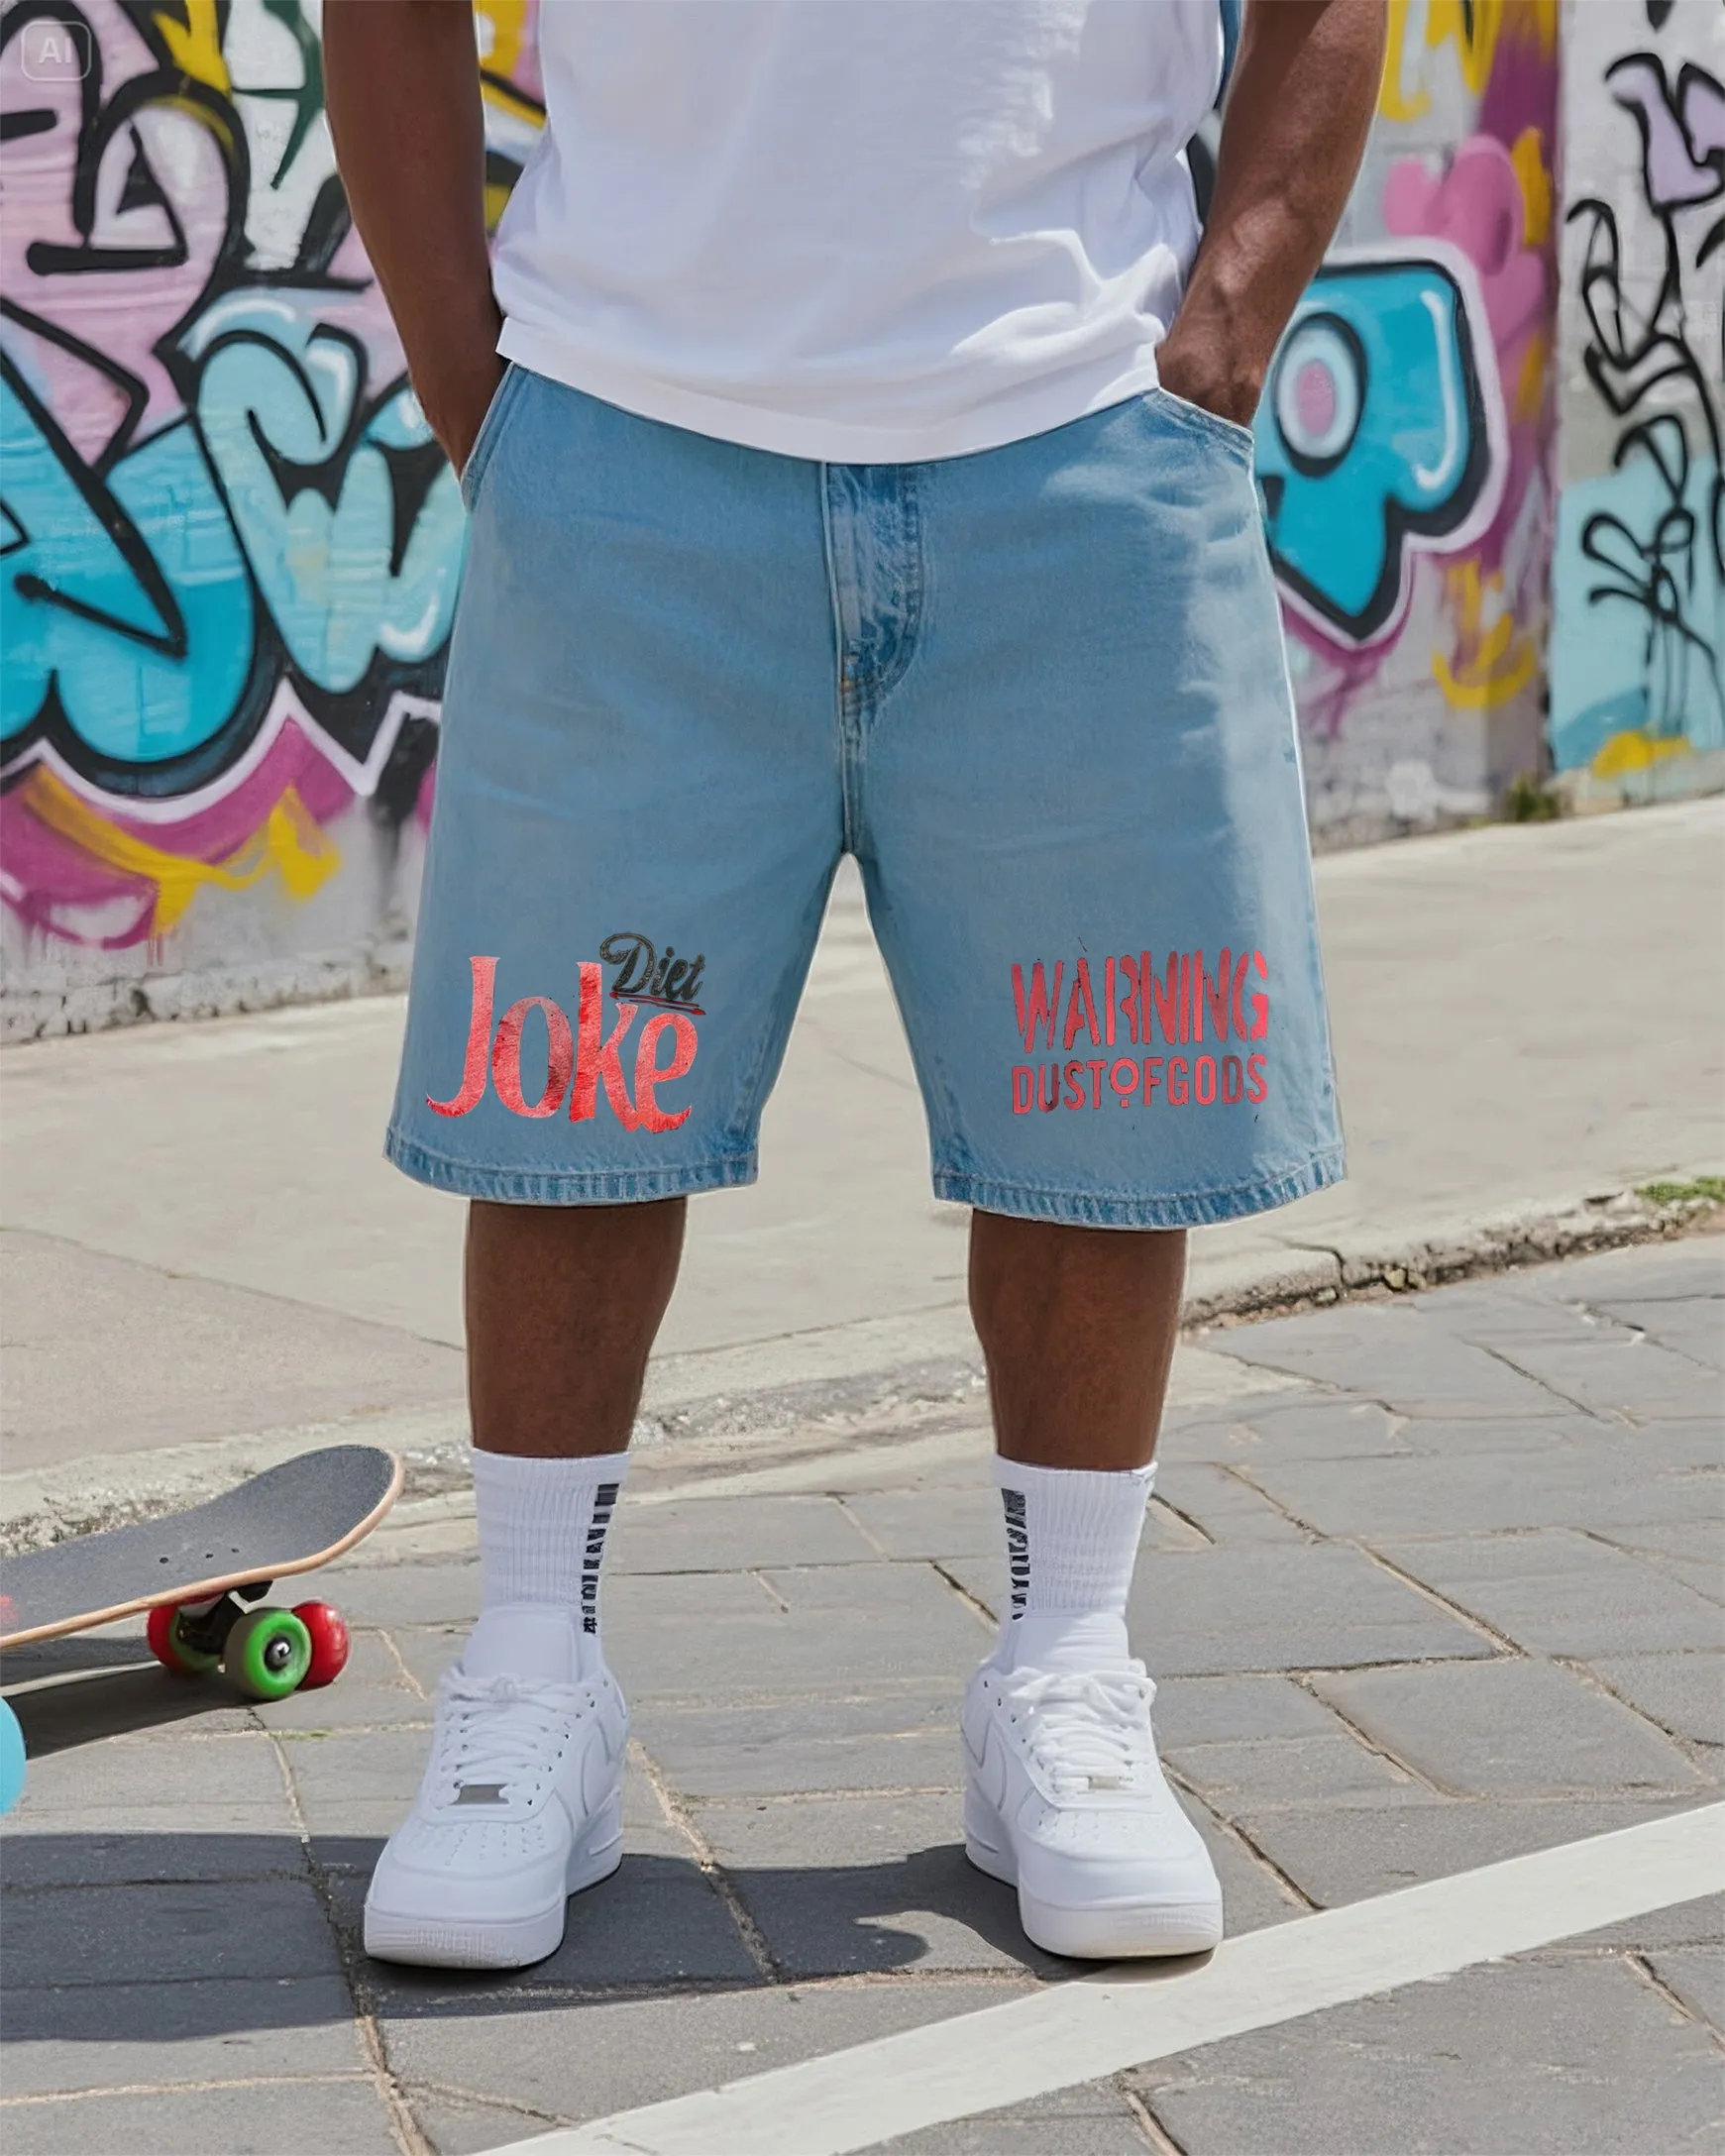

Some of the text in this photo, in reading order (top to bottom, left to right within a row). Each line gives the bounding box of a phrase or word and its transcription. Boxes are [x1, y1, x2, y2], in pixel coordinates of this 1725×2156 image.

[599, 932, 706, 1001] Diet
[1011, 945, 1269, 1053] WARNING
[425, 955, 699, 1133] Joke
